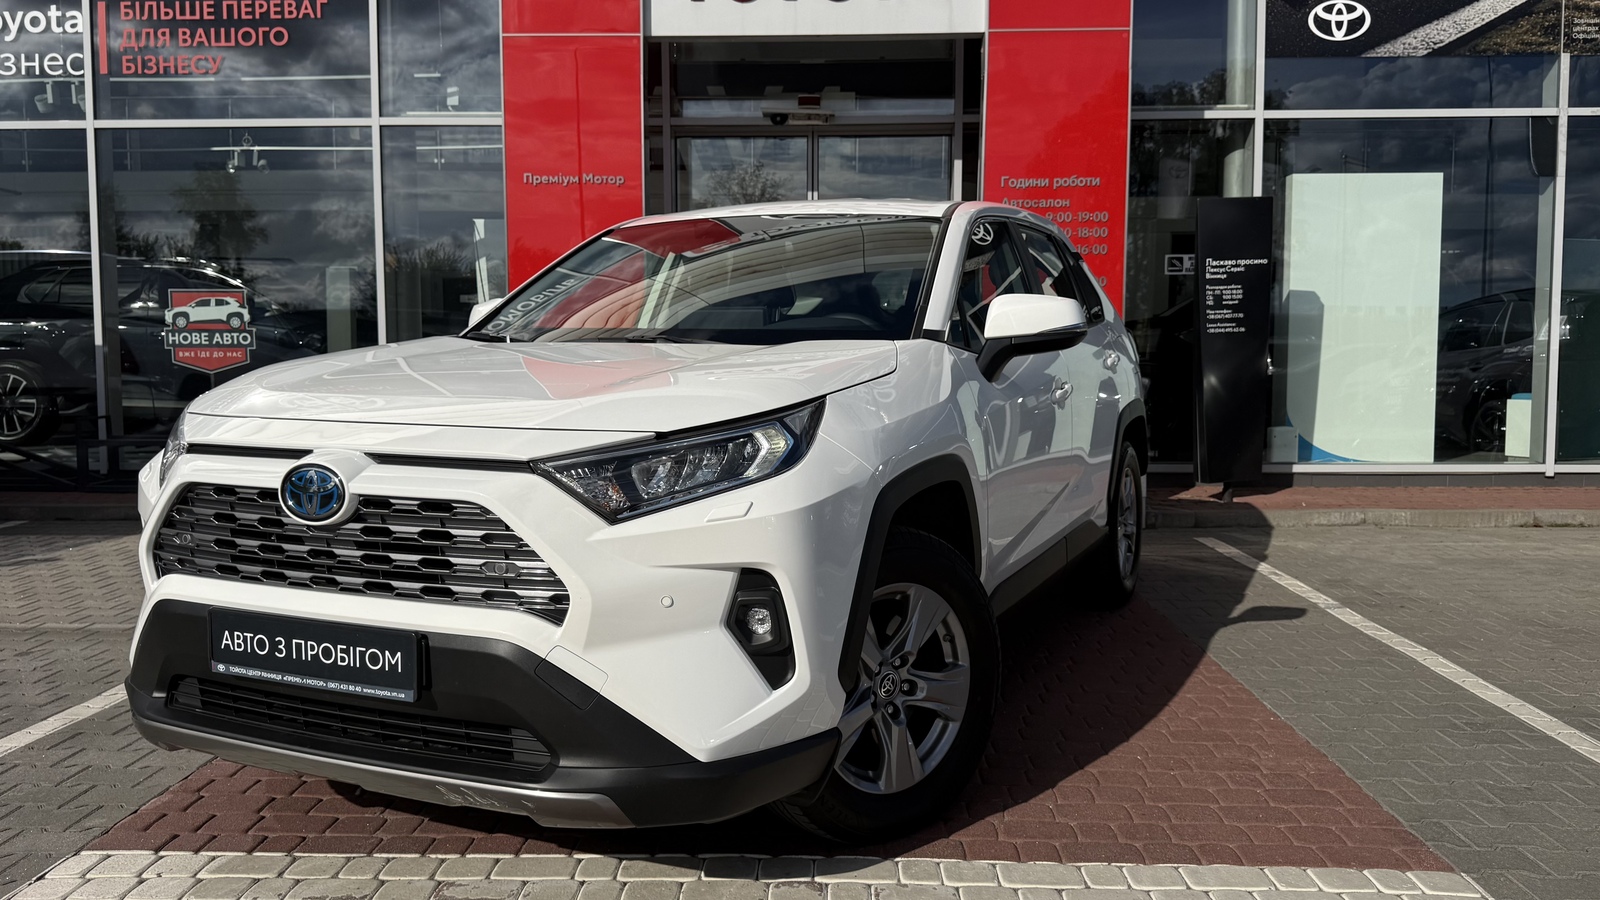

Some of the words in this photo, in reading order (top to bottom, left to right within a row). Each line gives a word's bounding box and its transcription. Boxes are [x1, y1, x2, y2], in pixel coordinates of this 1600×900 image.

[120, 1, 215, 20] БІЛЬШЕ
[222, 0, 328, 19] ПЕРЕВАГ
[0, 4, 83, 41] yota
[120, 28, 170, 51] ДЛЯ
[178, 27, 289, 47] ВАШОГО
[122, 55, 222, 75] БІЗНЕСУ
[523, 173, 580, 187] Преміум
[583, 173, 625, 187] Мотор
[1001, 176, 1049, 189] Години
[1053, 175, 1101, 190] роботи
[1002, 197, 1070, 208] Автосалон
[1206, 258, 1236, 266] Ласкаво
[1237, 258, 1268, 266] просимо
[168, 332, 209, 345] НОВЕ
[212, 332, 251, 345] АВТО
[198, 350, 210, 358] ЇДЕ
[221, 630, 269, 655] АВТО
[274, 637, 286, 658] З
[292, 639, 402, 673] ПРОБІГОМ
[229, 666, 247, 675] ТОЙОТА
